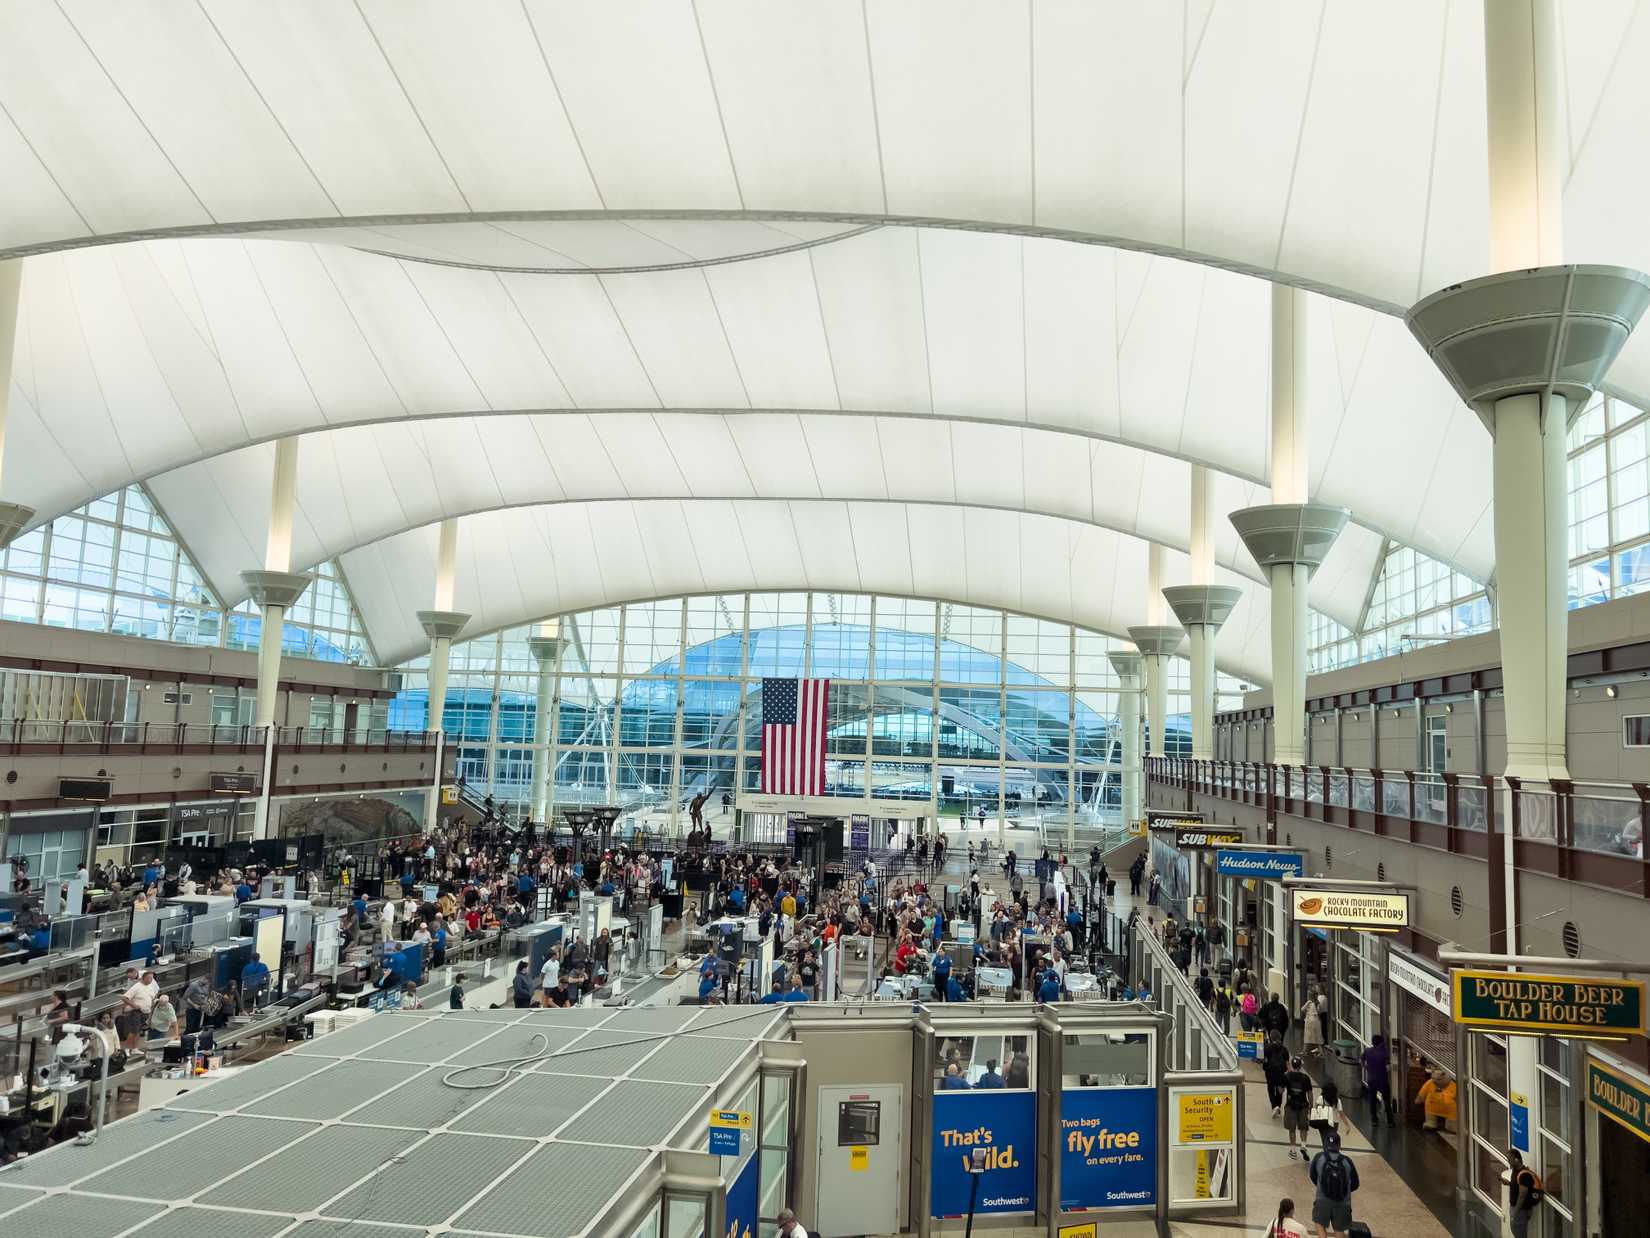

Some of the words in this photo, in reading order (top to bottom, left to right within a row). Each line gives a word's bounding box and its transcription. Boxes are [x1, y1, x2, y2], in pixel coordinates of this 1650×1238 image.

[181, 809, 190, 817] TSA
[1220, 856, 1265, 870] Hudson
[1265, 859, 1300, 871] News
[1327, 897, 1349, 907] ROCKY
[1350, 898, 1388, 909] MOUNTAIN
[1323, 906, 1367, 918] CHOCOLATE
[1368, 908, 1405, 921] FACTORY
[1475, 978, 1565, 1002] BOULDER
[1574, 984, 1625, 1006] BEER
[1494, 999, 1532, 1019] TAP
[1538, 1002, 1608, 1025] HOUSE
[1193, 1097, 1214, 1106] South
[1593, 1073, 1641, 1121] BOULDER
[1184, 1106, 1214, 1115] Security
[1061, 1119, 1080, 1128] Two
[1081, 1118, 1101, 1128] bags
[1067, 1130, 1096, 1157] fly
[1098, 1128, 1140, 1150] free
[1086, 1157, 1098, 1165] on
[1098, 1155, 1124, 1165] every
[1124, 1153, 1144, 1163] fare.
[1106, 1190, 1146, 1200] Southwest
[982, 1196, 1024, 1207] Southwest
